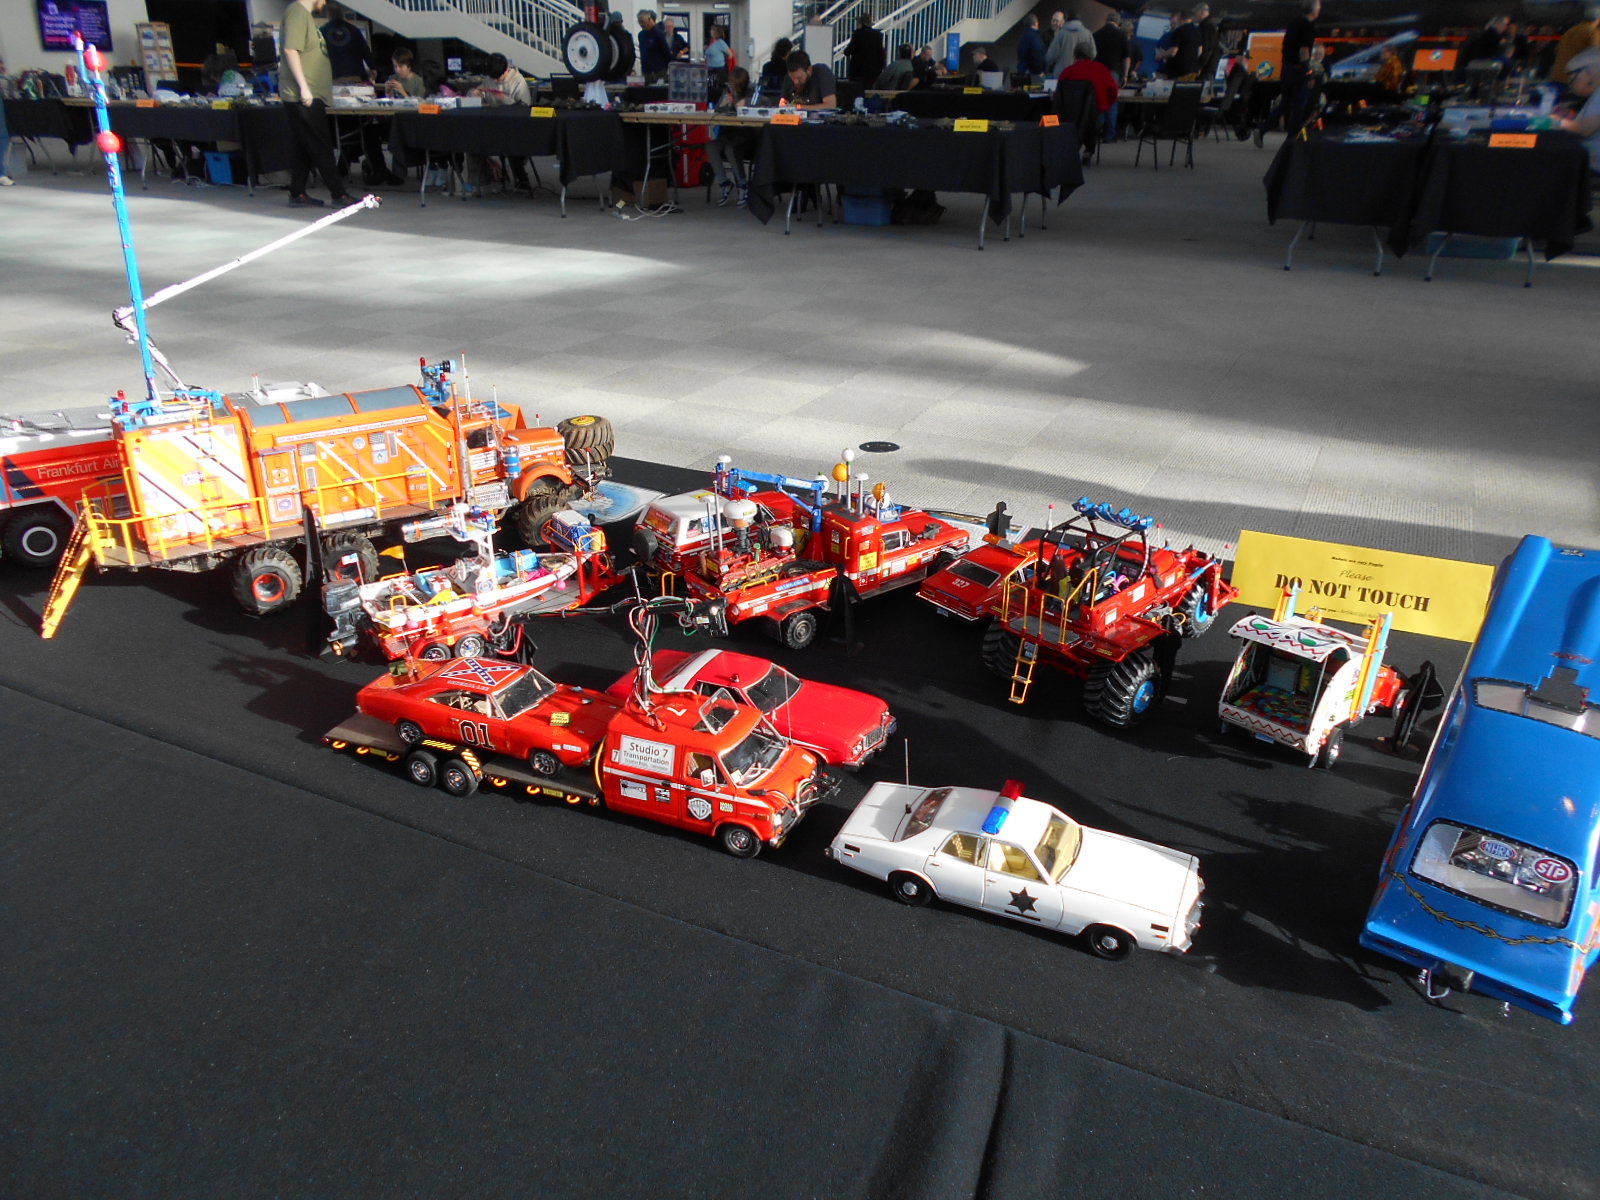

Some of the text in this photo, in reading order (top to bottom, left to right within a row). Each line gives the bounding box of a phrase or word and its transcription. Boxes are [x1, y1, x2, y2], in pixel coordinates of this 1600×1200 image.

[37, 460, 99, 480] Frankfurt
[1339, 569, 1374, 582] Please
[1274, 573, 1303, 590] DO
[1308, 579, 1351, 600] NOT
[1357, 586, 1431, 612] TOUCH
[458, 719, 497, 751] 01
[613, 750, 619, 761] 7
[622, 750, 671, 766] Transportation
[629, 742, 669, 759] Studio 7
[1485, 842, 1512, 858] NHRA
[1535, 860, 1566, 878] STP
